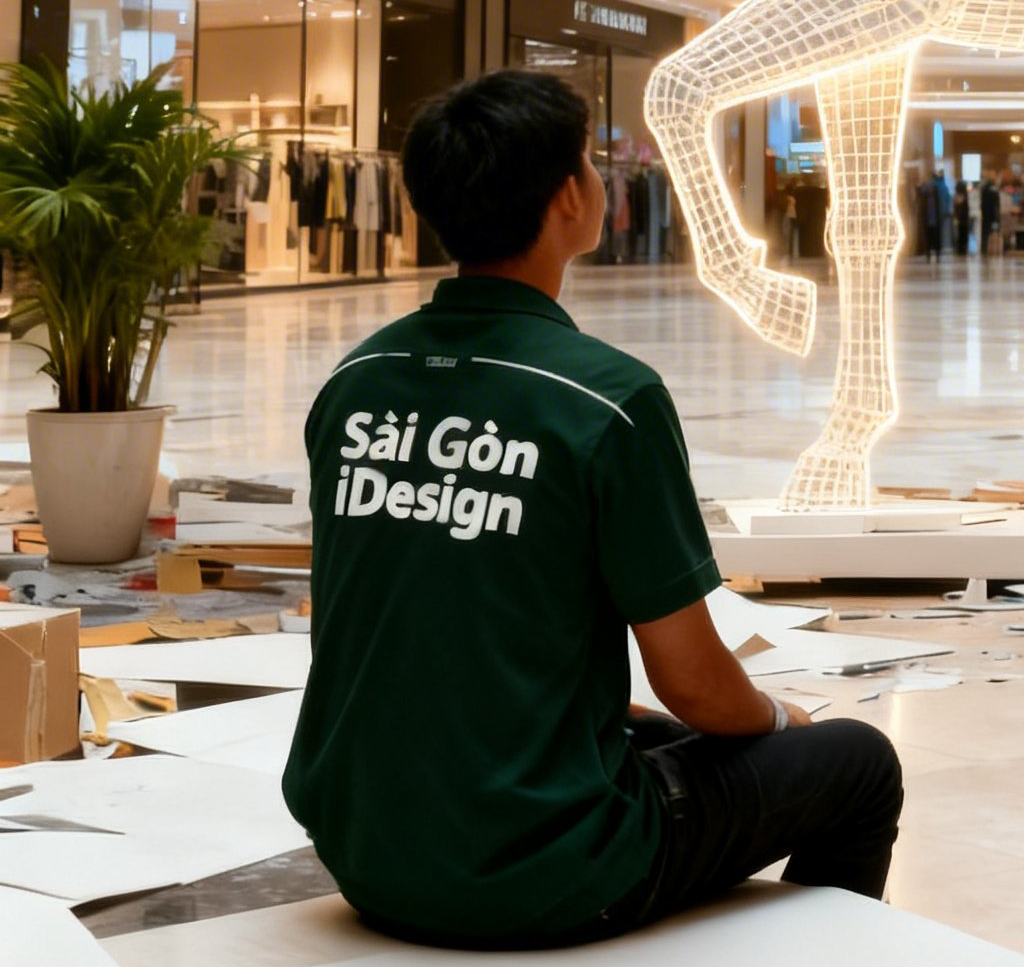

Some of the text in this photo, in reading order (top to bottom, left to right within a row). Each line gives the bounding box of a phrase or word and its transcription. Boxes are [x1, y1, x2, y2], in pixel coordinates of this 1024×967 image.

[340, 410, 539, 480] Sài Gòn
[334, 464, 523, 541] iDesign
